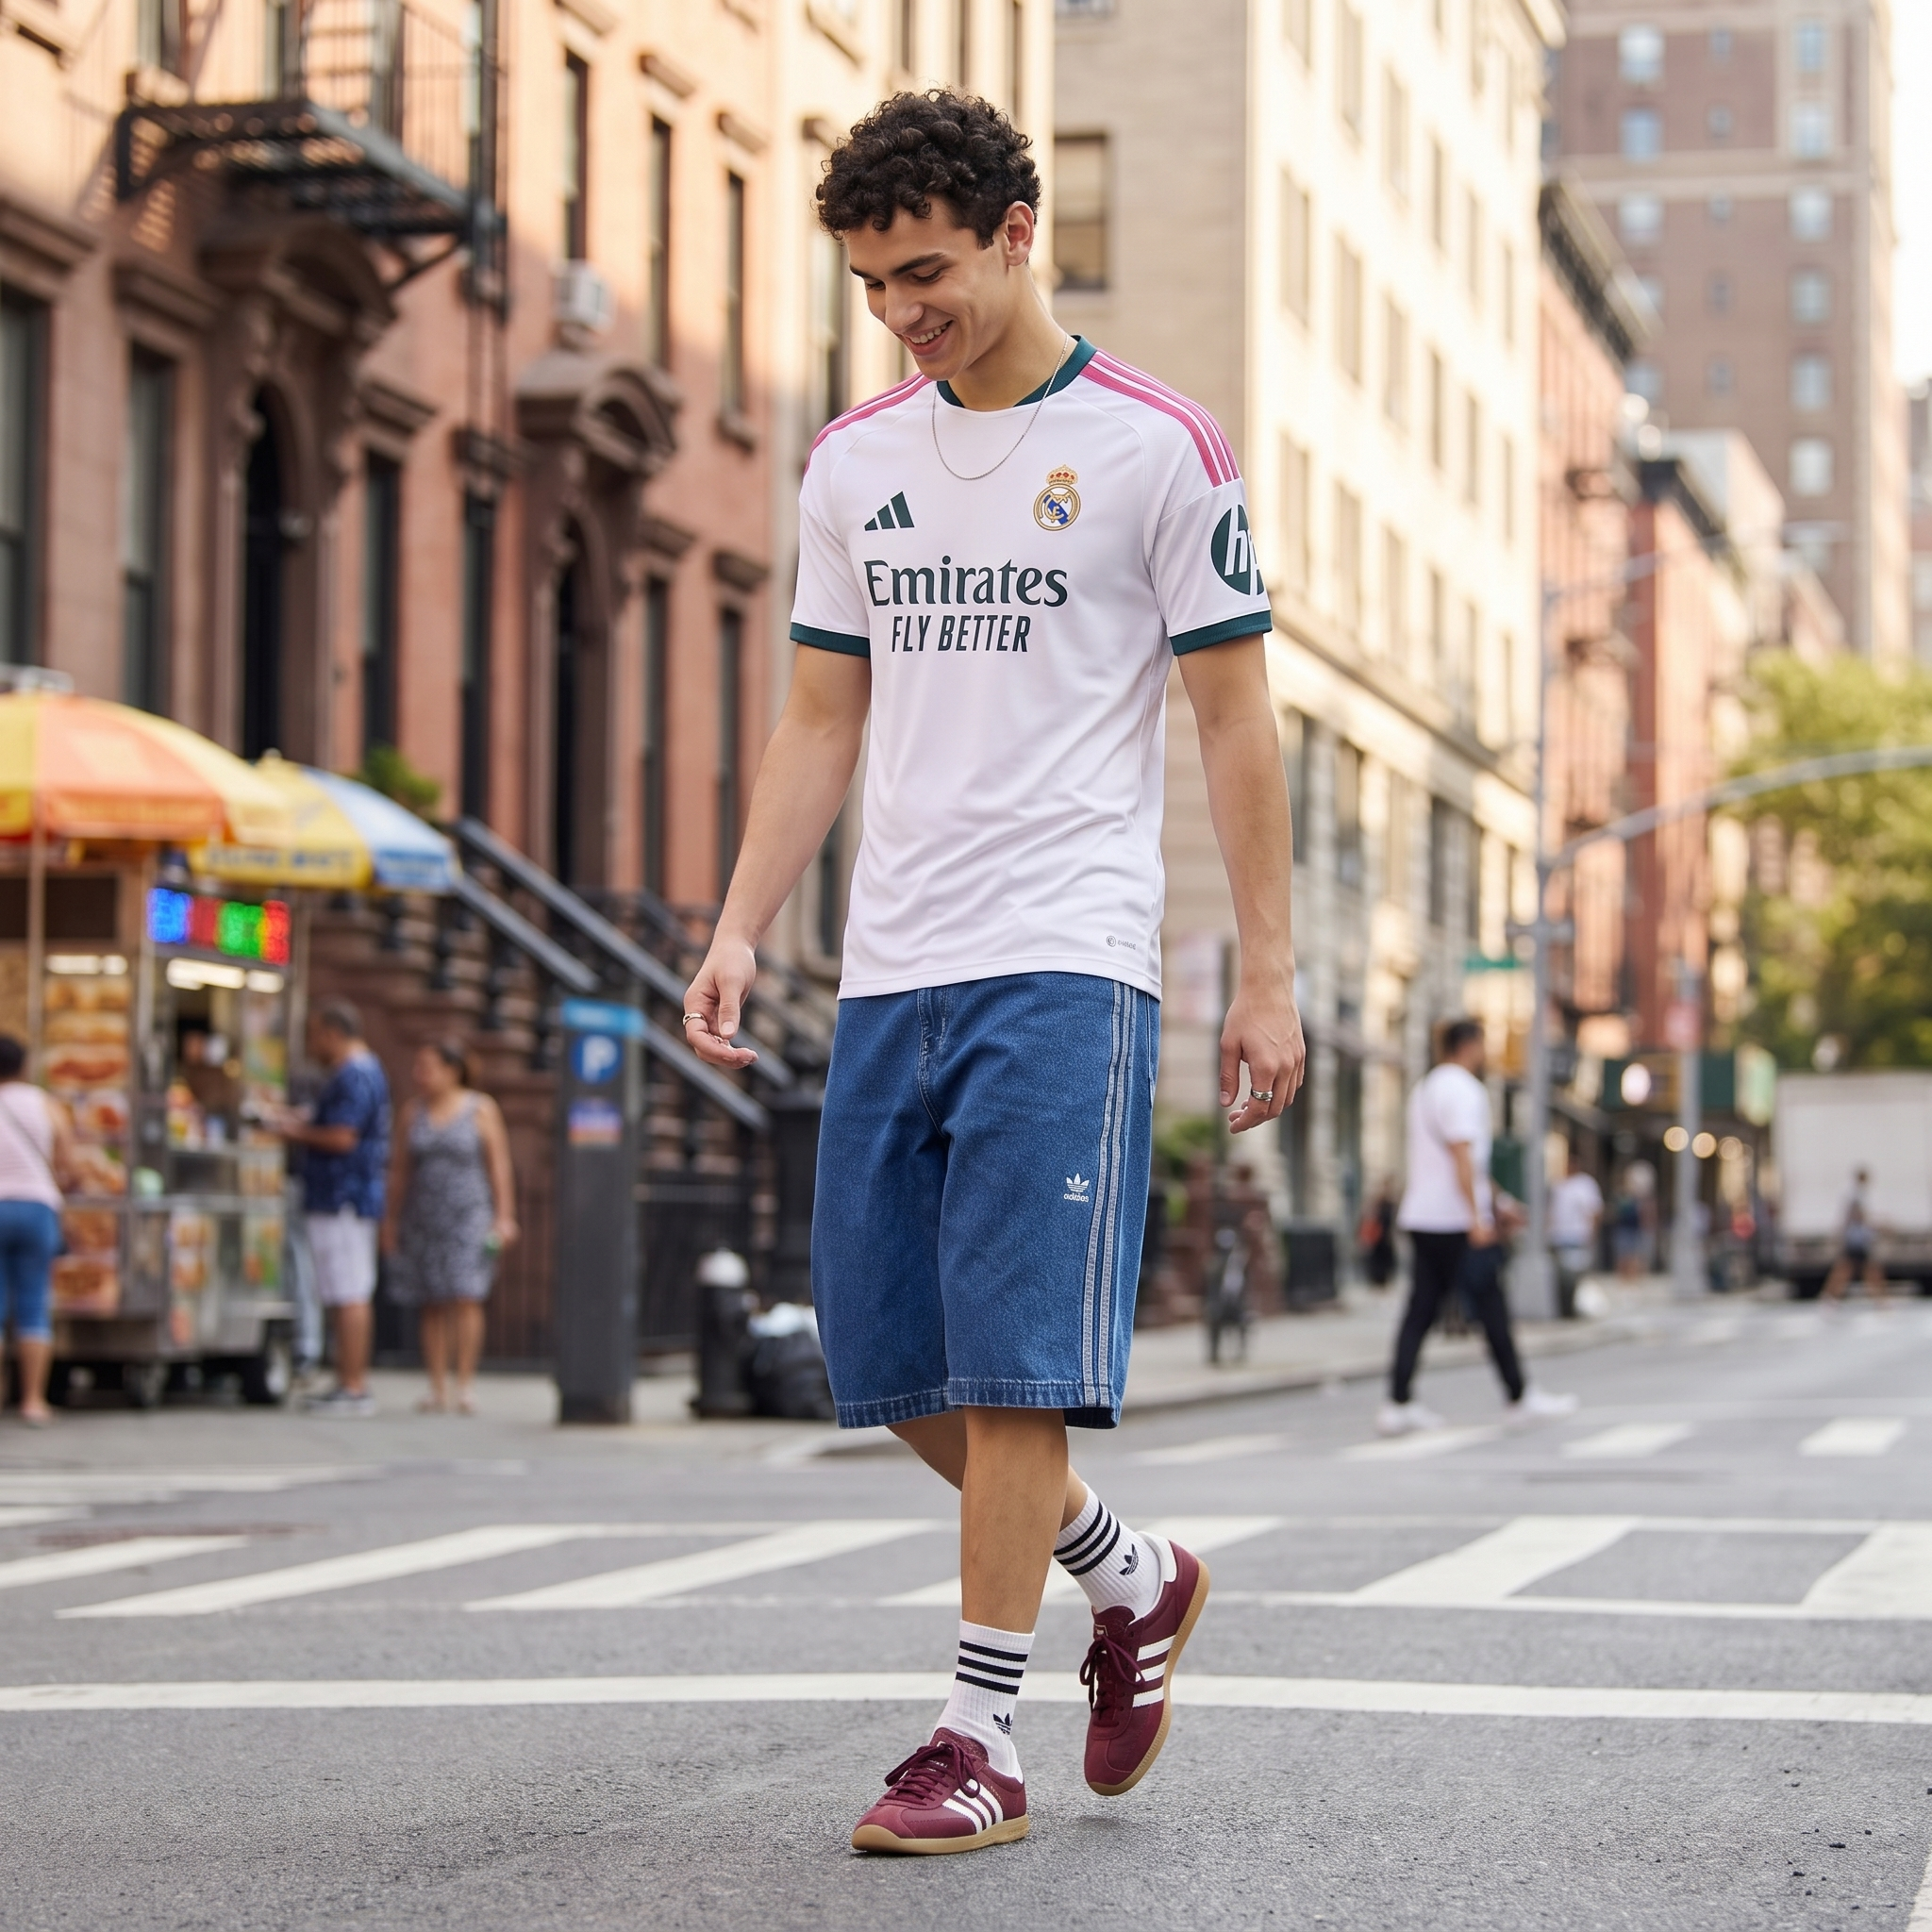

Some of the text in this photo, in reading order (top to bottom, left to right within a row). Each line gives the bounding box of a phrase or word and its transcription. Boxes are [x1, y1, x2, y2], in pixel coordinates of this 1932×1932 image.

[863, 555, 1068, 608] Emirates
[891, 615, 1031, 653] FLY BETTER
[581, 1035, 619, 1083] P
